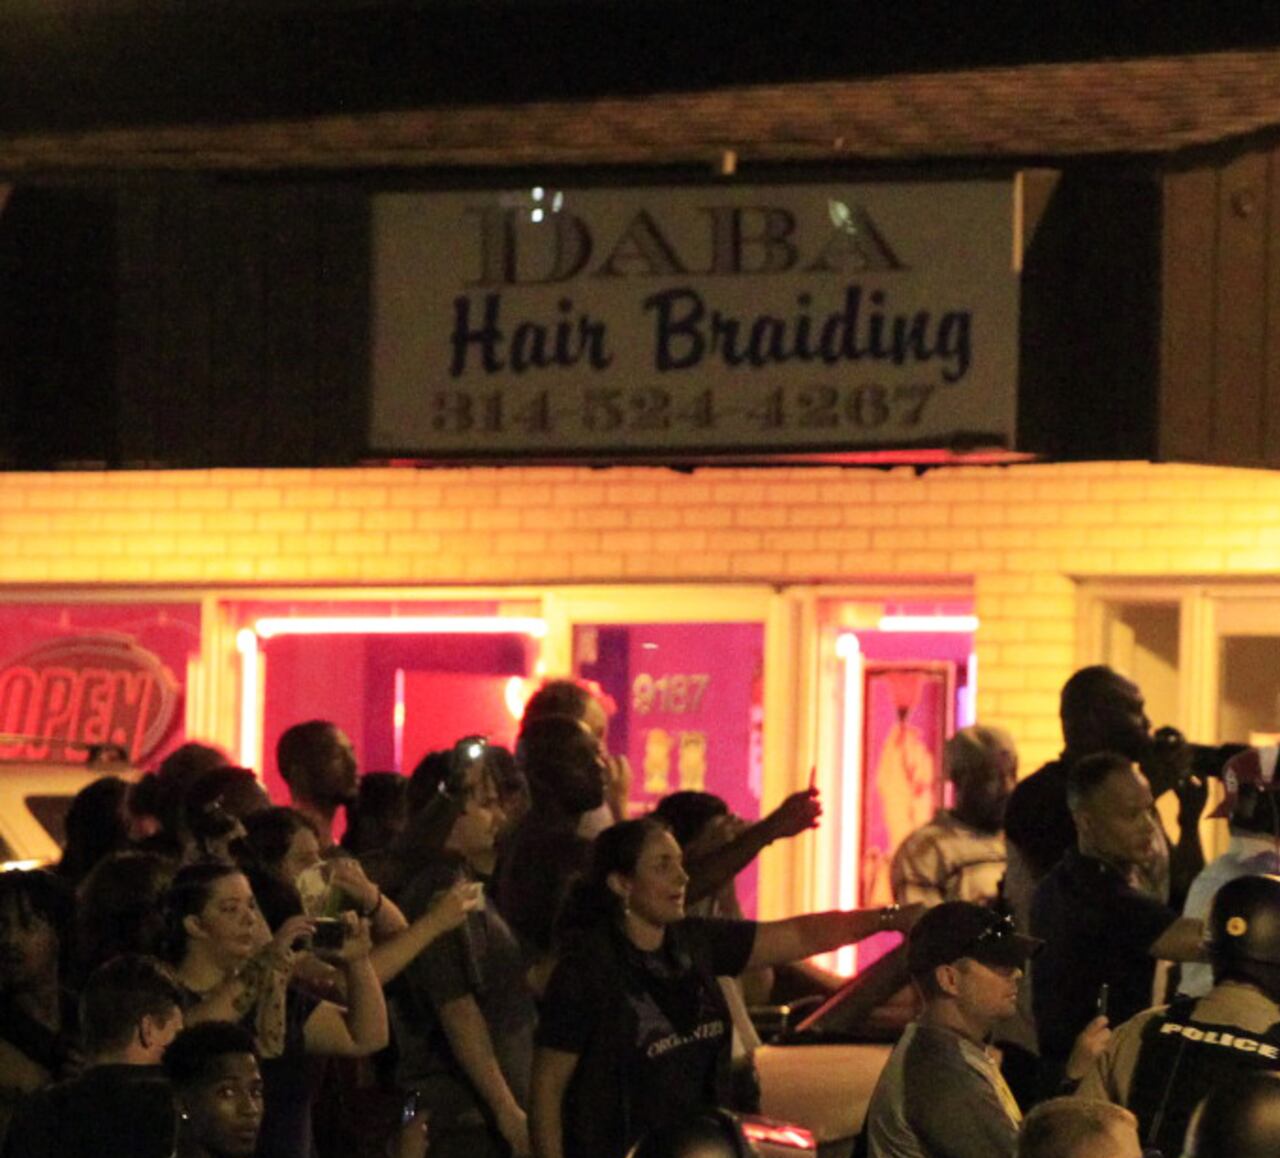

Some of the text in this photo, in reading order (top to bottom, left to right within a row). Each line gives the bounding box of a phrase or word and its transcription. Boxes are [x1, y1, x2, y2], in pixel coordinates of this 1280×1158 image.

[464, 202, 914, 288] DABA
[449, 285, 973, 382] Hair Braiding
[430, 384, 936, 434] 314-524-4267
[0, 666, 153, 763] OPEN
[632, 672, 711, 715] 9187
[1160, 1022, 1280, 1059] POLICE
